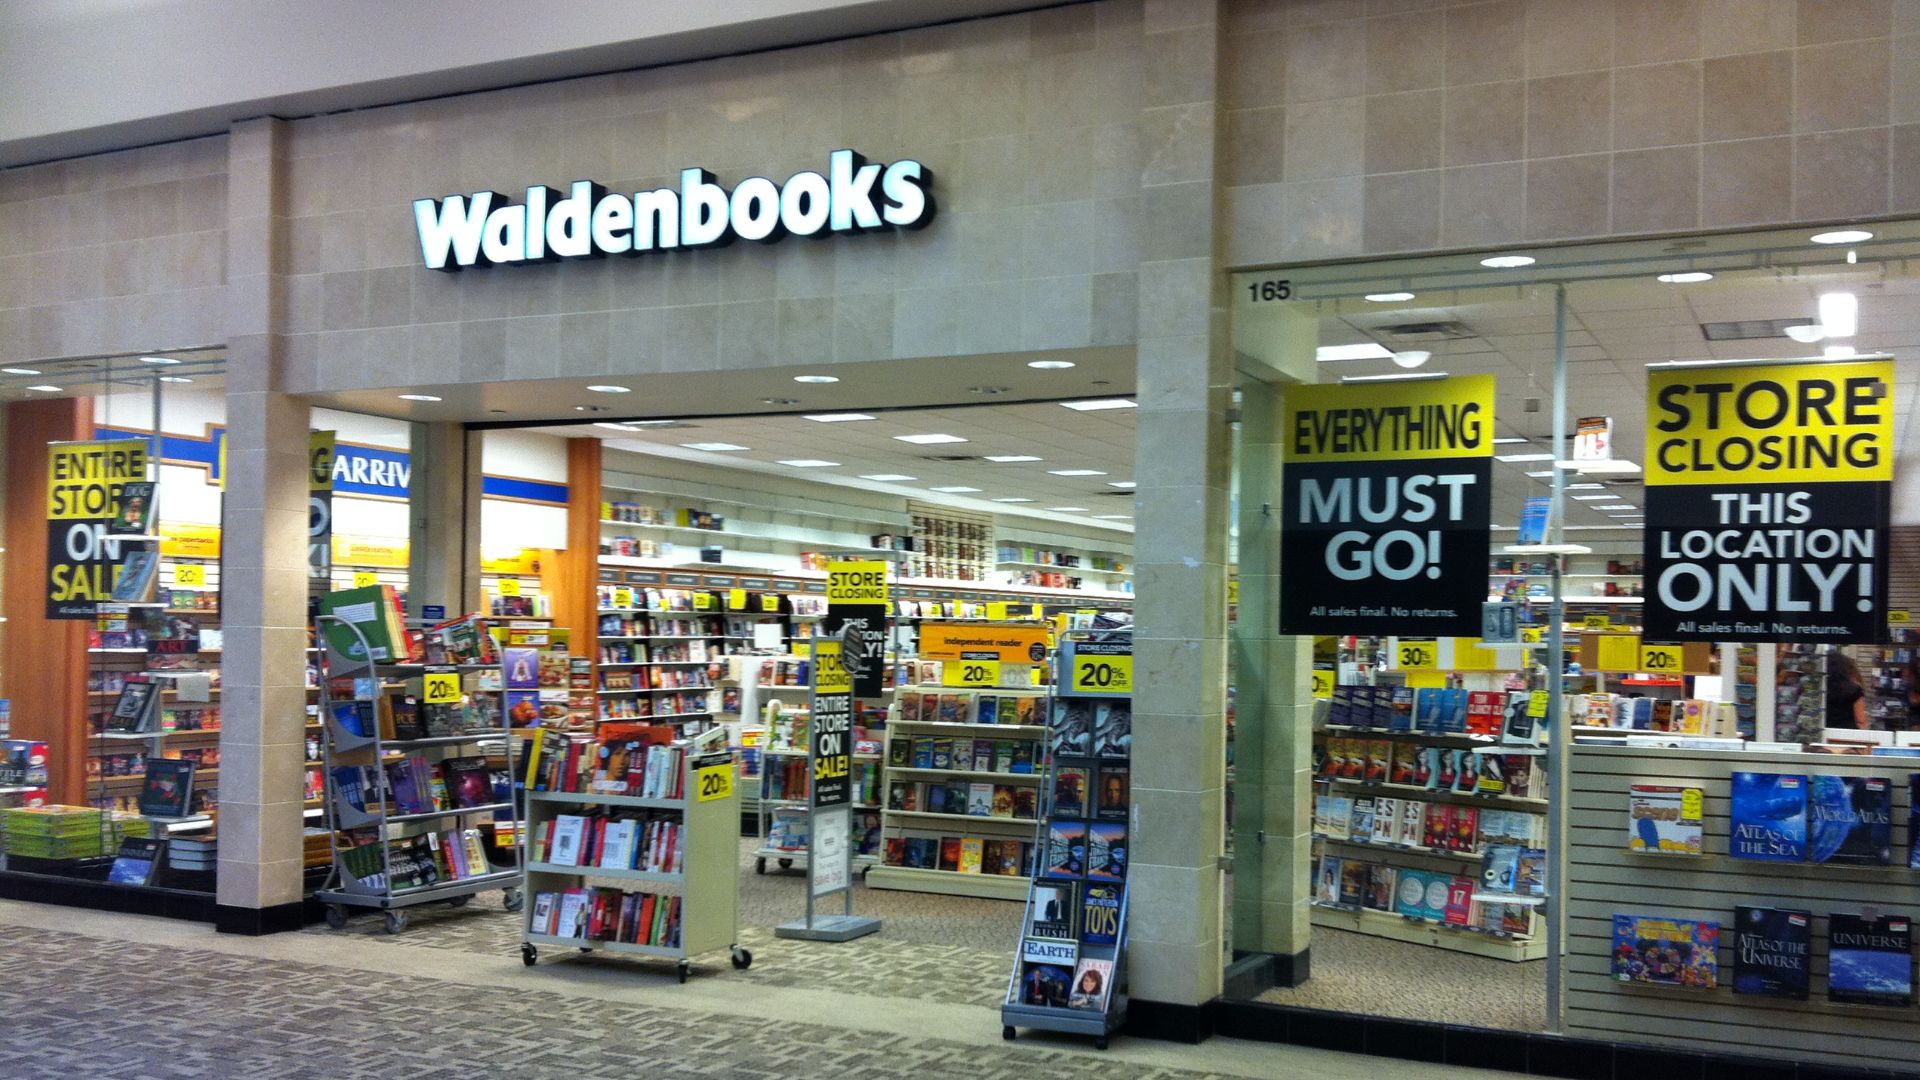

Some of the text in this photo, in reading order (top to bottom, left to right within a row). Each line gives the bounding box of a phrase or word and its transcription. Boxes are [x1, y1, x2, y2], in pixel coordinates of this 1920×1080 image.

[414, 149, 927, 270] Waldenbooks
[1248, 280, 1291, 302] 165
[1656, 376, 1880, 433] STORE
[1294, 402, 1481, 454] EVERYTHING
[1657, 433, 1879, 473] CLOSING
[53, 450, 146, 480] ENTIRE
[332, 455, 410, 488] ARRIV
[52, 484, 124, 515] STOR
[1300, 473, 1477, 524] MUST
[1711, 491, 1813, 525] THIS
[66, 523, 120, 560] ON
[1660, 529, 1875, 559] LOCATION
[1325, 530, 1442, 581] GO!
[829, 571, 885, 587] STORE
[1657, 562, 1873, 613] ONLY!
[829, 588, 884, 599] CLOSING
[1309, 606, 1458, 618] All sales final. No returns.
[1676, 621, 1851, 635] All sales final. No returns.
[944, 636, 994, 648] independent
[815, 653, 845, 673] STOR
[815, 696, 849, 713] ENTIRE
[815, 714, 849, 733] STORE
[820, 734, 842, 756] ON
[815, 754, 849, 780] SALE!
[1857, 808, 1889, 824] ATLAS
[1734, 823, 1781, 840] ATLAS
[1739, 841, 1800, 857] THE SEA
[1084, 904, 1118, 936] TOYS
[1034, 927, 1068, 939] BUSH
[1738, 933, 1770, 949] ATLAS
[1833, 932, 1908, 949] UNIVERSE
[1026, 941, 1076, 959] EARTH
[1742, 948, 1802, 970] UNIVERSE
